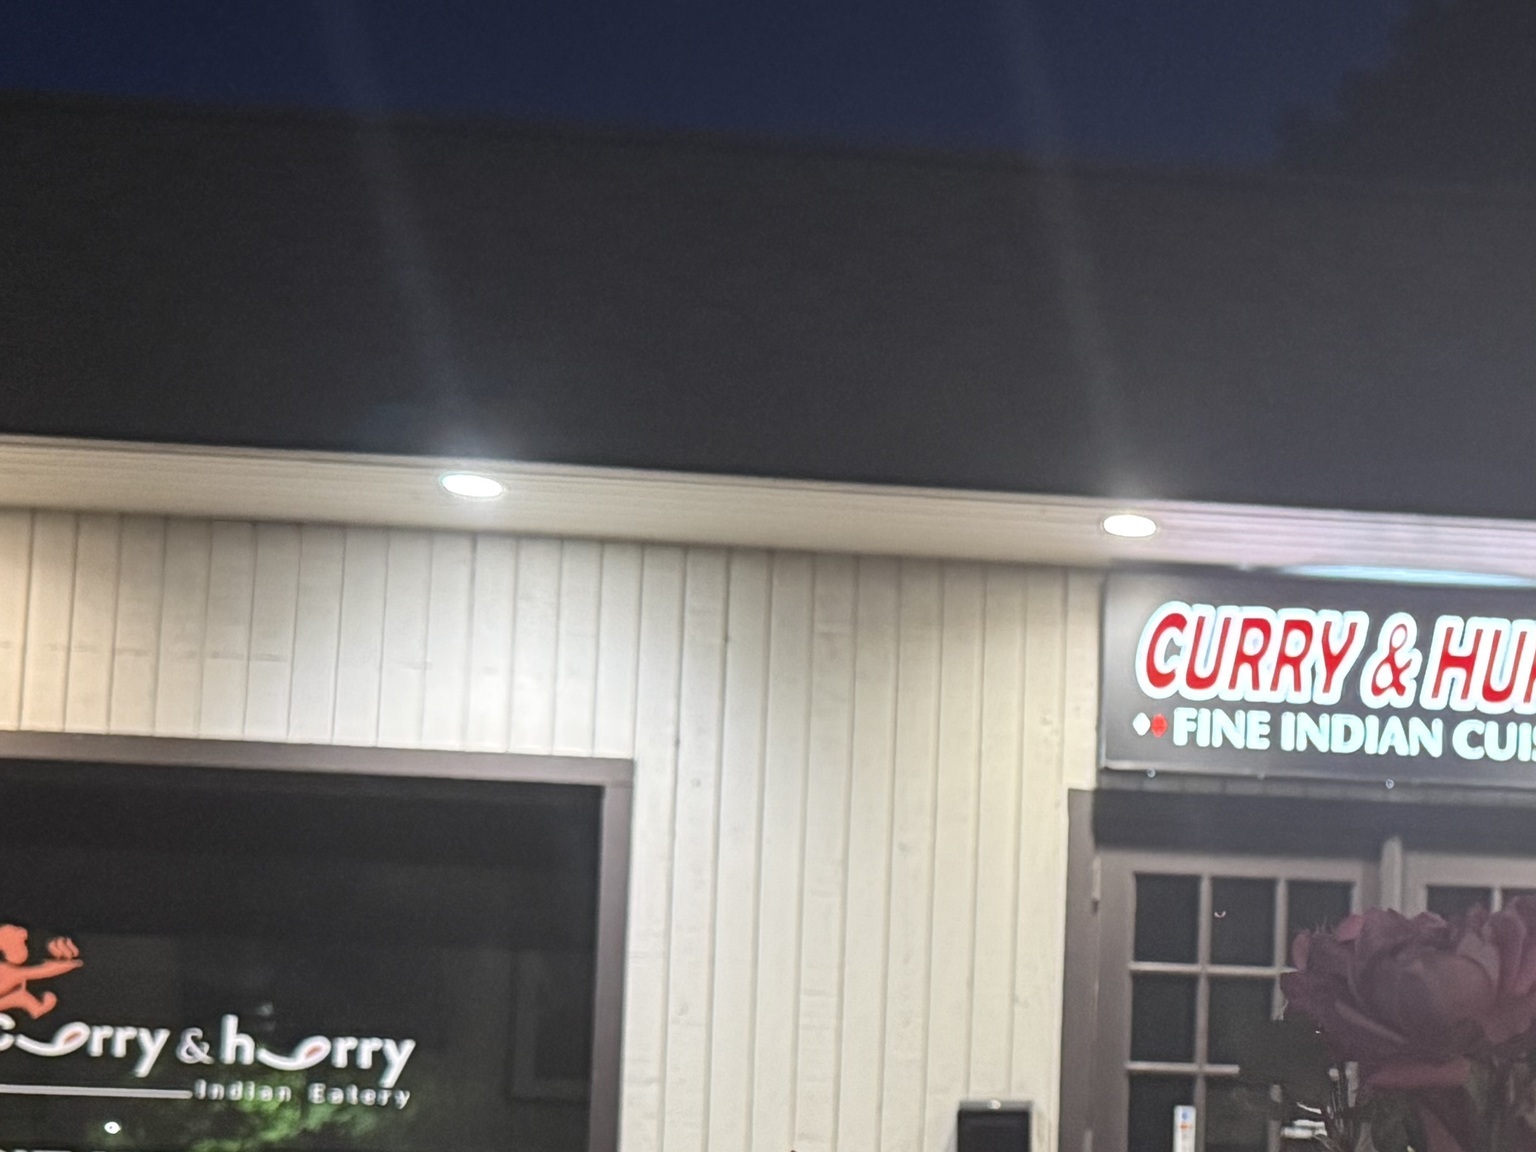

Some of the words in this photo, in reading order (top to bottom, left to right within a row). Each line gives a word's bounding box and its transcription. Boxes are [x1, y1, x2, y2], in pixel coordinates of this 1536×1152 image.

[1138, 603, 1366, 702] CURRY
[1363, 615, 1420, 704] &
[1173, 708, 1271, 749] FINE
[1280, 712, 1443, 758] INDIAN
[176, 1027, 215, 1065] &
[194, 1078, 292, 1103] Indian
[307, 1082, 411, 1110] Eatery
